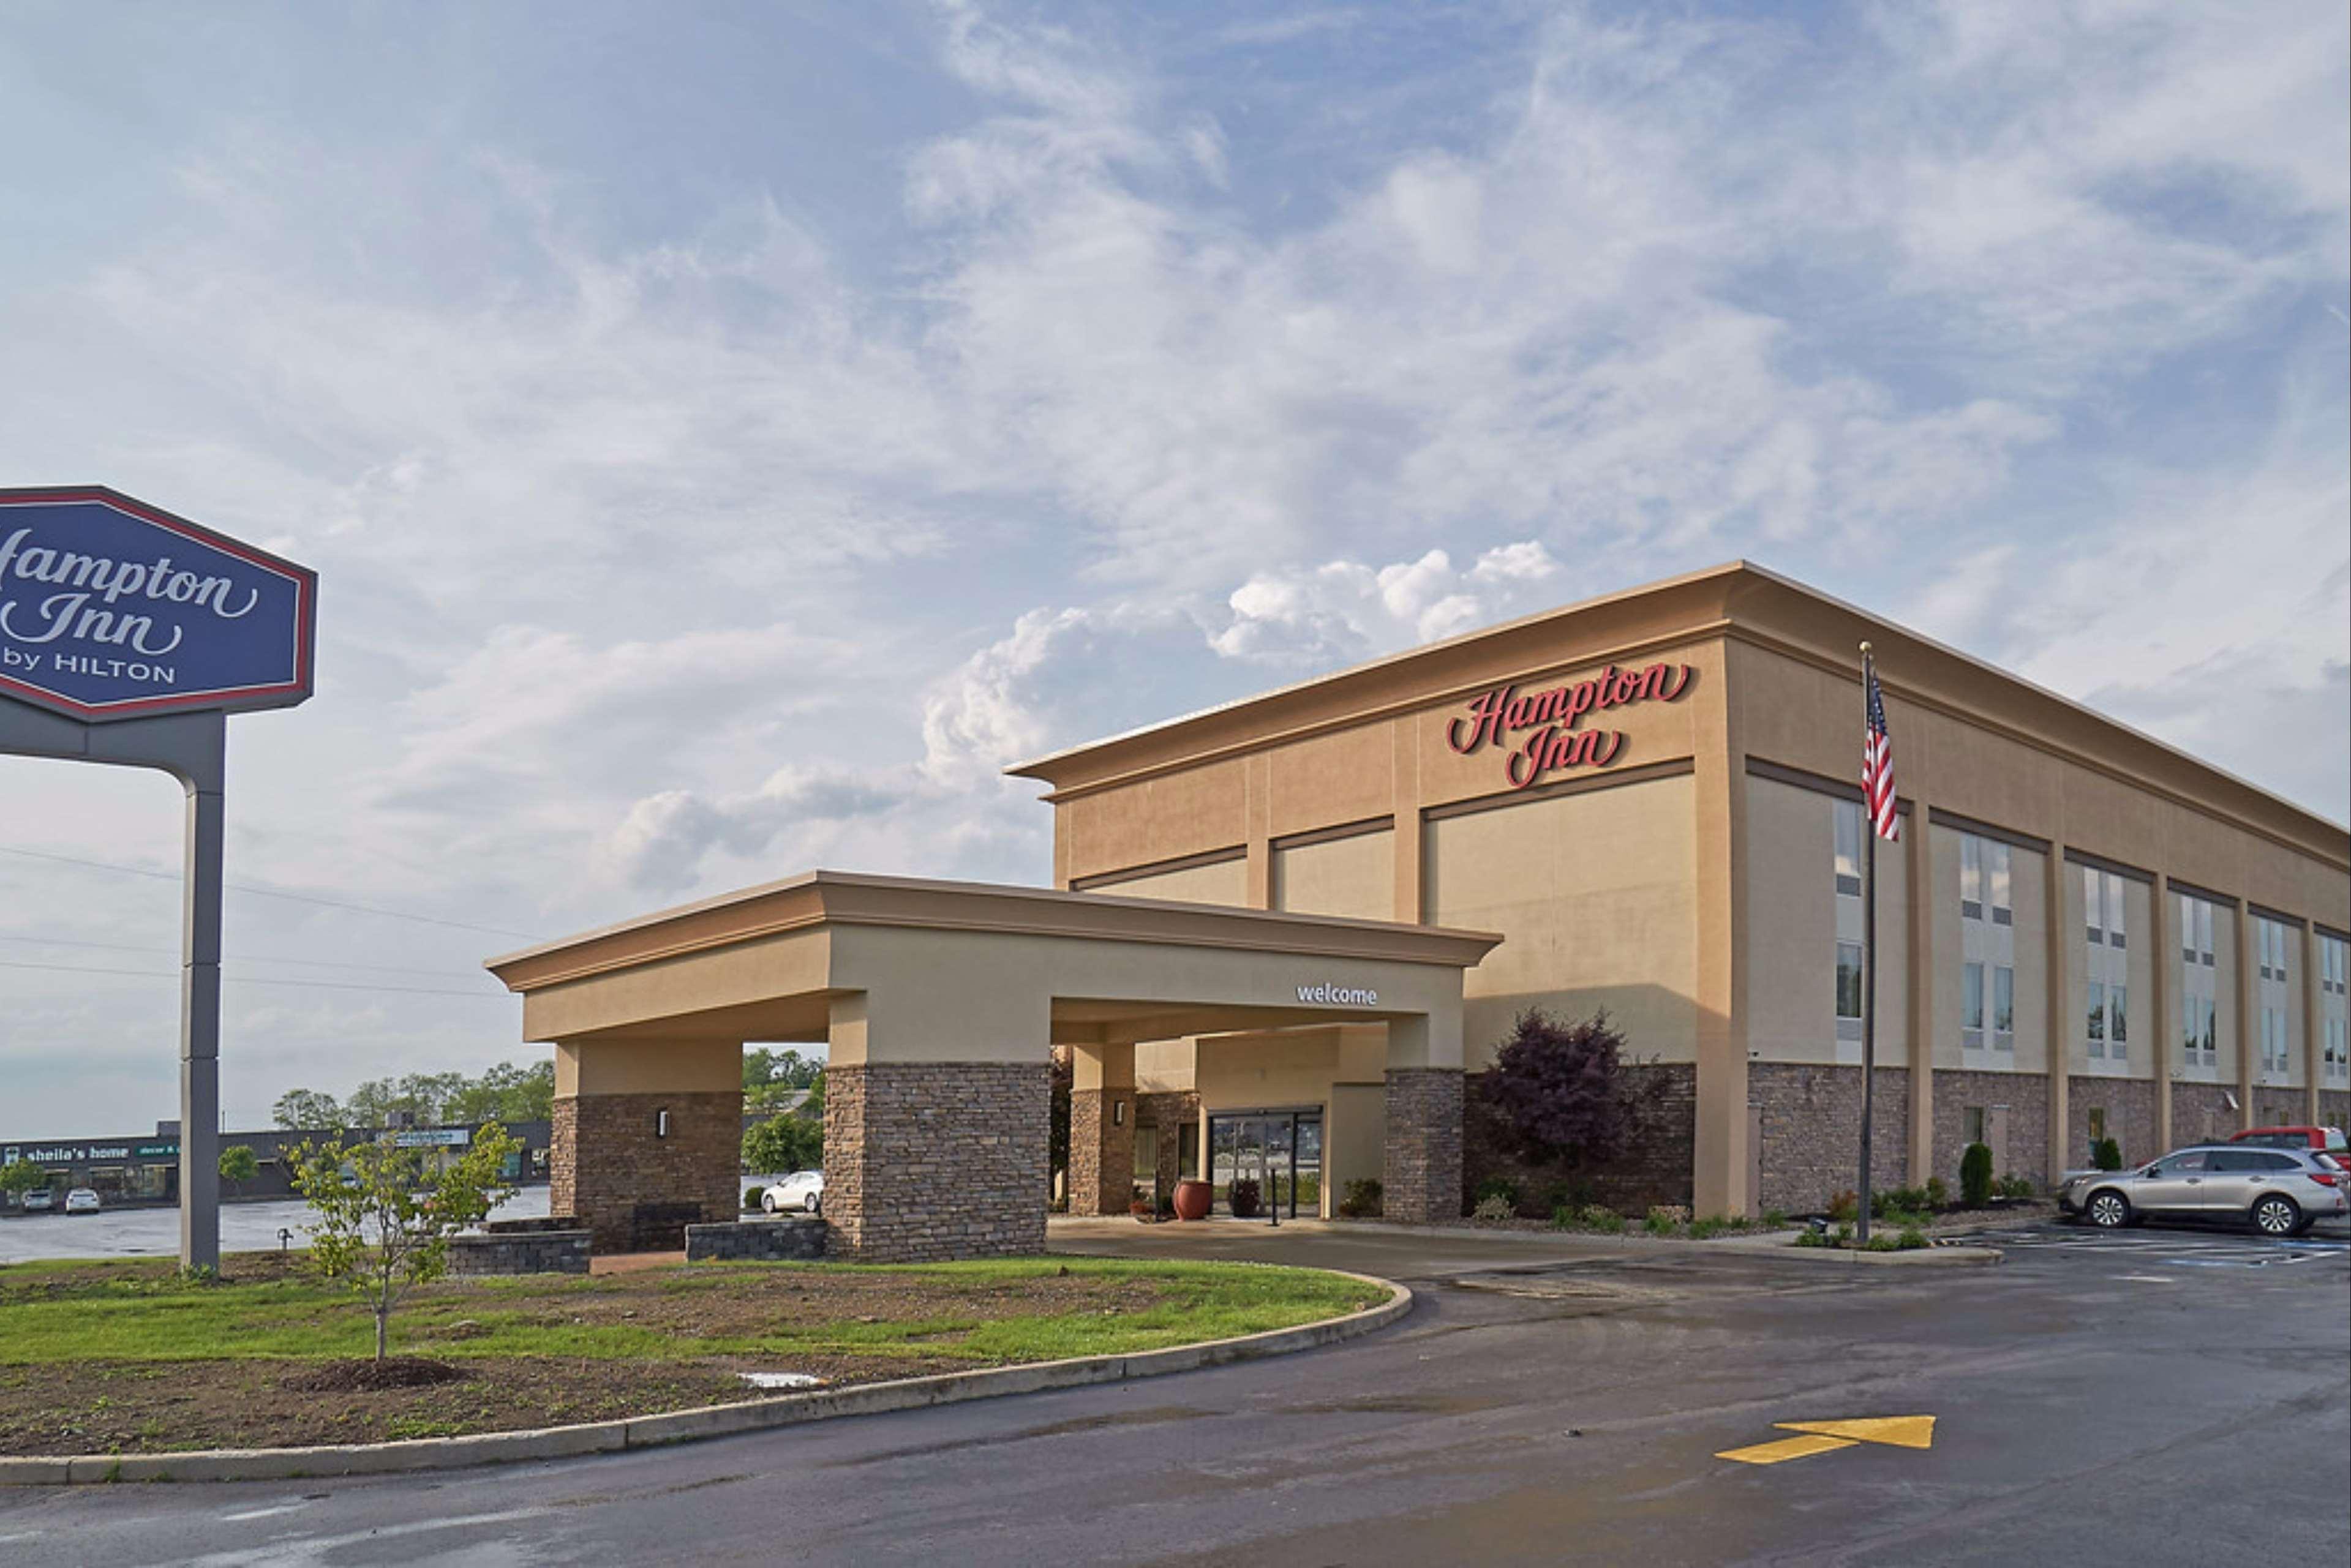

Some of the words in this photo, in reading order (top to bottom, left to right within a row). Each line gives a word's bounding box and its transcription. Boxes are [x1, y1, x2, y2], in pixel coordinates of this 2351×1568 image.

[0, 593, 182, 655] Inn
[4, 646, 41, 670] by
[55, 653, 175, 684] HILTON
[1446, 662, 1690, 754] Hampton
[1505, 725, 1623, 789] Inn
[1296, 982, 1377, 1005] welcome
[89, 1146, 129, 1158] home
